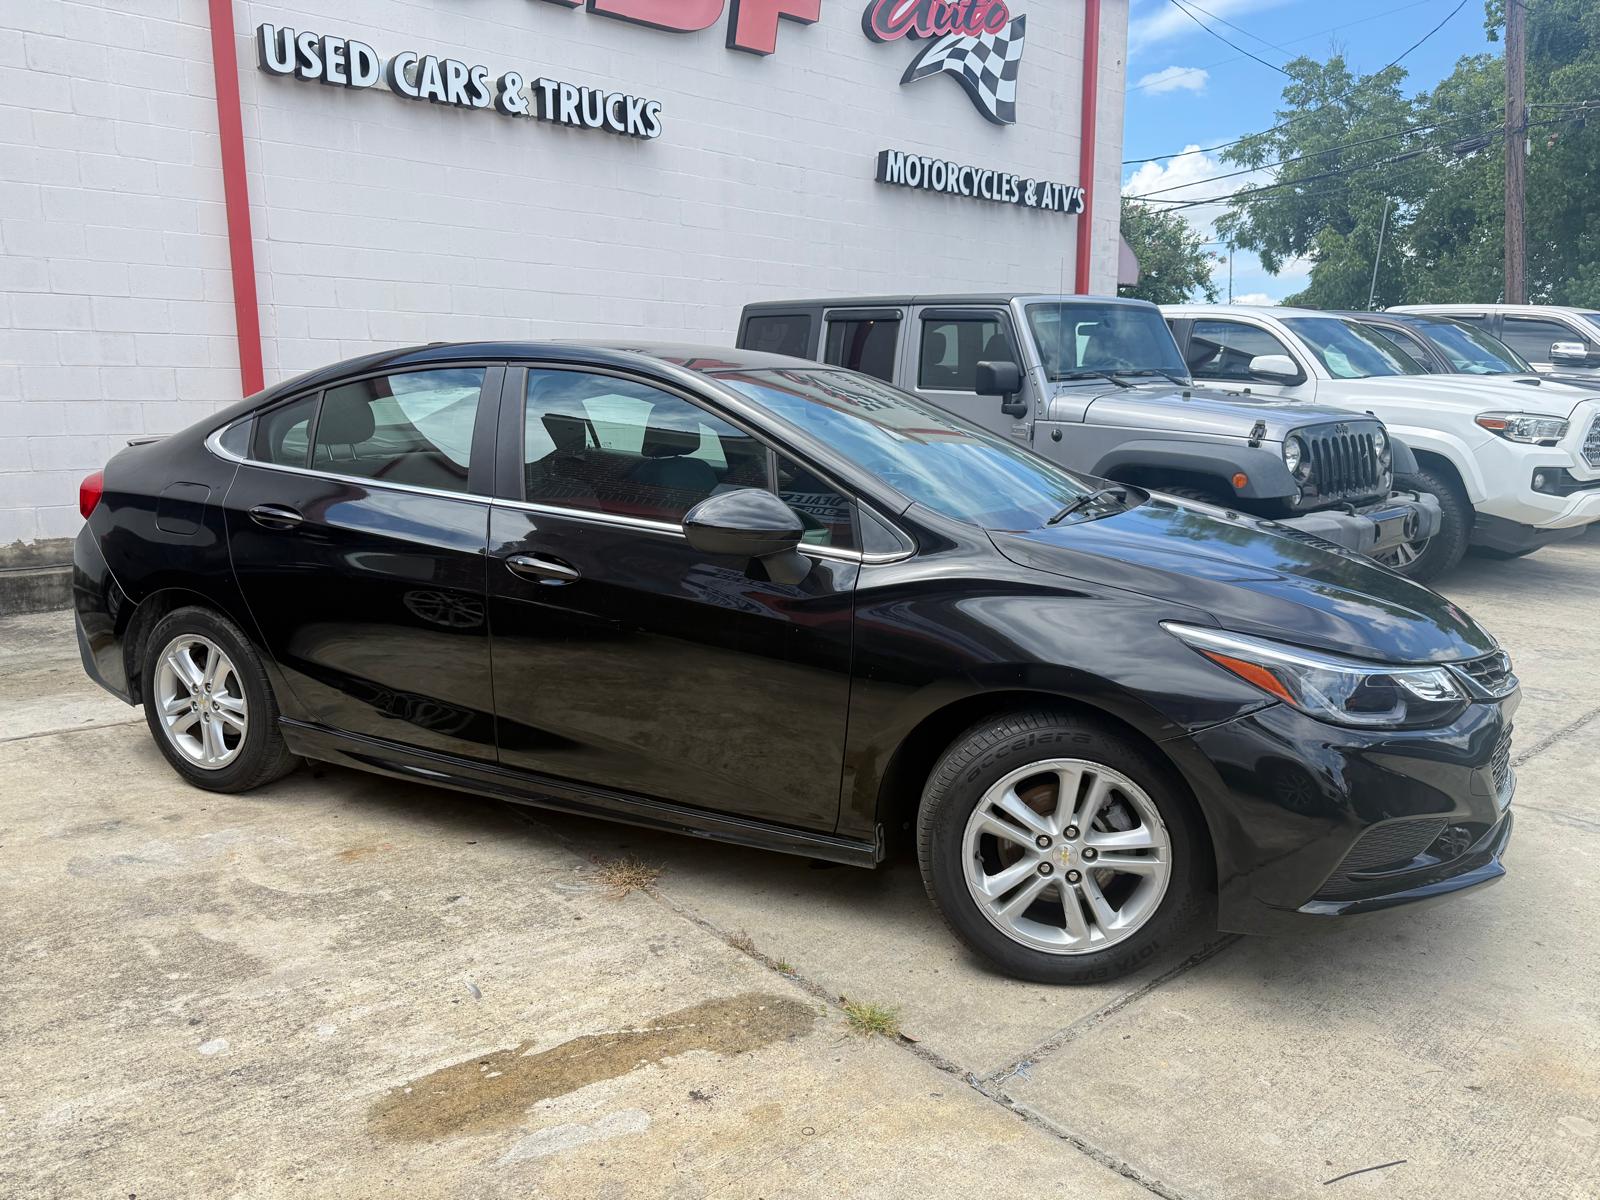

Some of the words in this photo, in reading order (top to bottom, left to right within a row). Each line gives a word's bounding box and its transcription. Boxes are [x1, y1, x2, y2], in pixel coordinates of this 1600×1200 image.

[864, 0, 1009, 41] Auto
[259, 23, 380, 89] USED
[388, 51, 491, 109] CARS
[497, 71, 530, 117] &
[533, 77, 663, 140] TRUCKS
[881, 149, 1019, 203] MOTORCYCLES
[1023, 178, 1037, 207] &
[1041, 181, 1085, 215] ATV'S
[966, 732, 1092, 783] accelera
